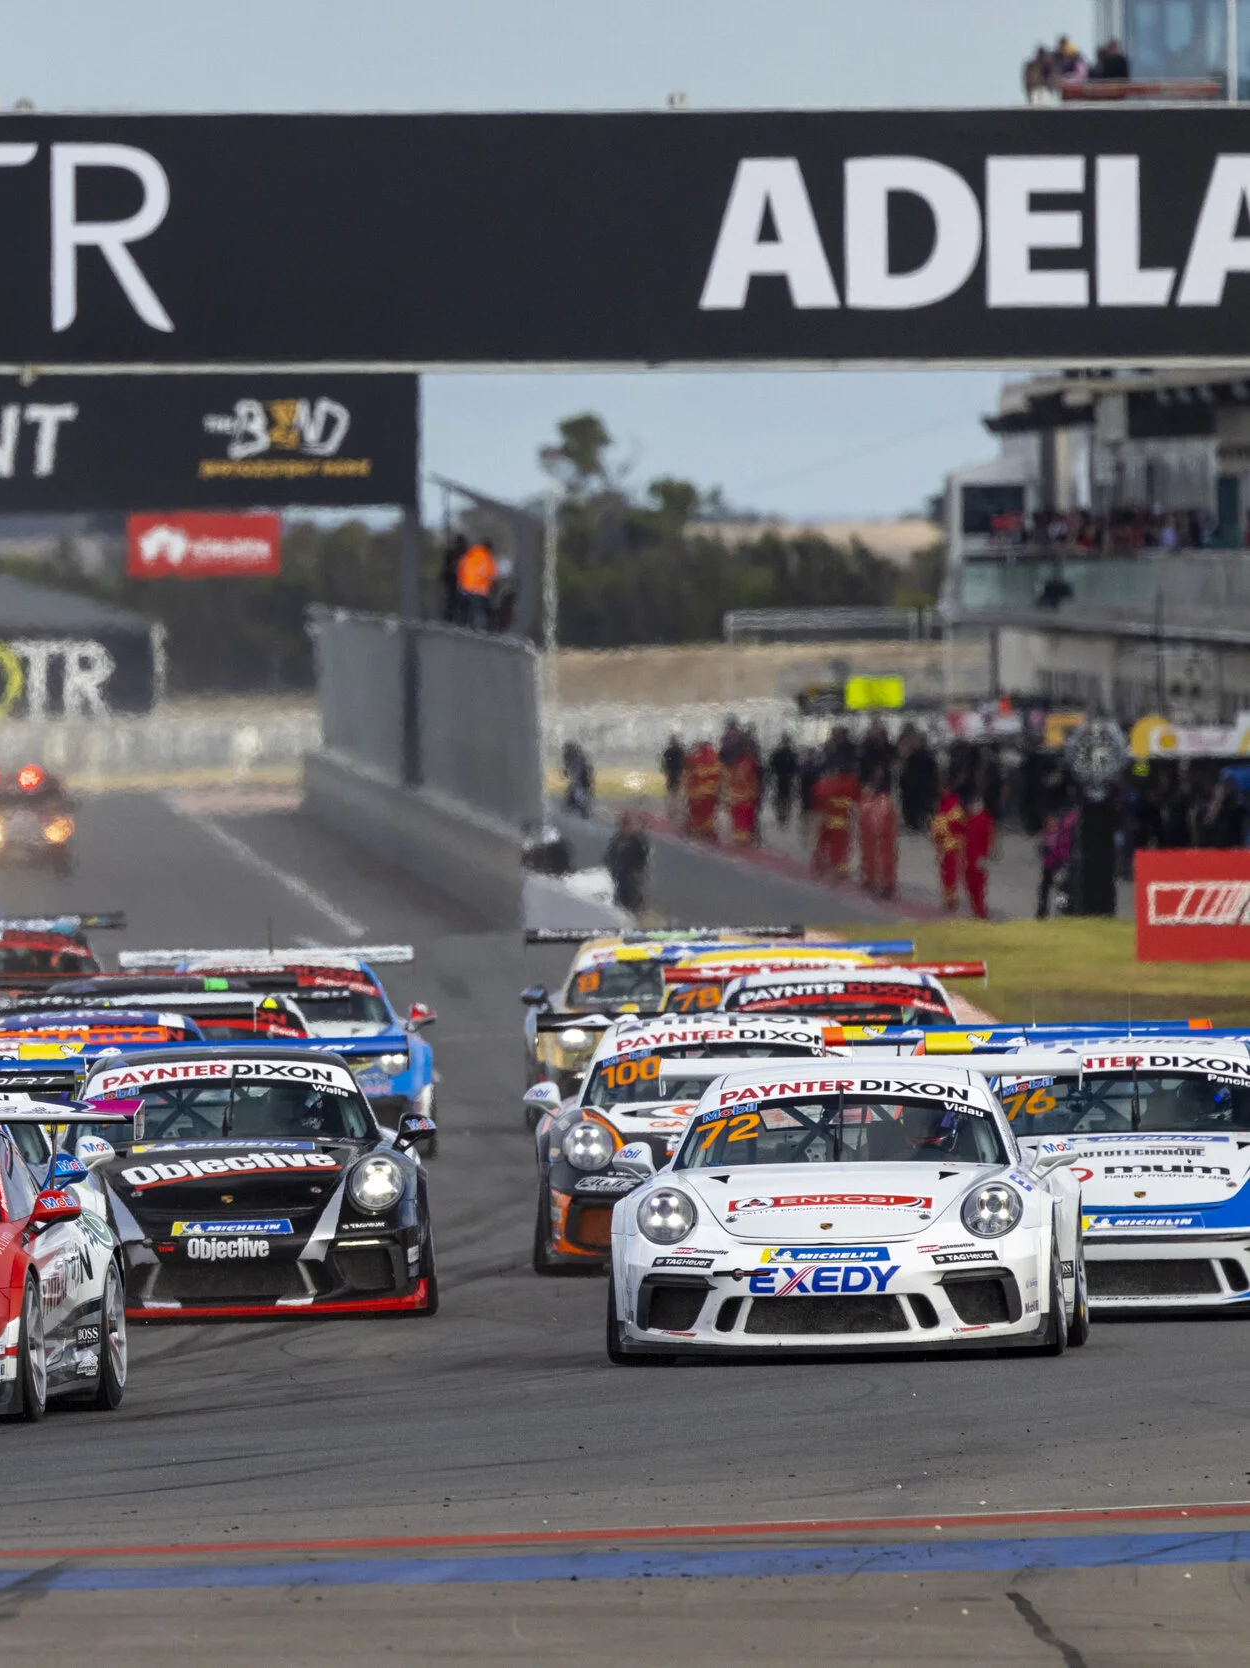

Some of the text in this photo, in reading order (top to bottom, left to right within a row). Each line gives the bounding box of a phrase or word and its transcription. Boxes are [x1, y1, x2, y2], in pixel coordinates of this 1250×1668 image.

[738, 981, 932, 1006] PAYNTER DIXON
[616, 1030, 734, 1052] PAYNTER
[601, 1055, 662, 1089] 100
[1082, 1055, 1250, 1073] NTER DIXON
[102, 1063, 333, 1090] PAYNTER DIXON
[312, 1084, 349, 1098] Walls
[720, 1079, 969, 1106] PAYNTER DIXON
[702, 1101, 760, 1123] Mobil
[943, 1101, 984, 1118] Vidau
[1002, 1088, 1057, 1122] 76
[696, 1113, 761, 1150] 72
[81, 1142, 111, 1153] Mob
[617, 1148, 642, 1159] obil
[121, 1152, 337, 1187] Objective
[1104, 1164, 1231, 1175] mum
[780, 1195, 896, 1205] ENKOSI
[206, 1223, 281, 1232] MICHELIN
[1114, 1217, 1193, 1226] MICHELIN
[187, 1237, 270, 1262] Objective
[796, 1251, 879, 1260] MICHELIN
[749, 1264, 901, 1297] EXEDY
[78, 1327, 99, 1340] BOSS
